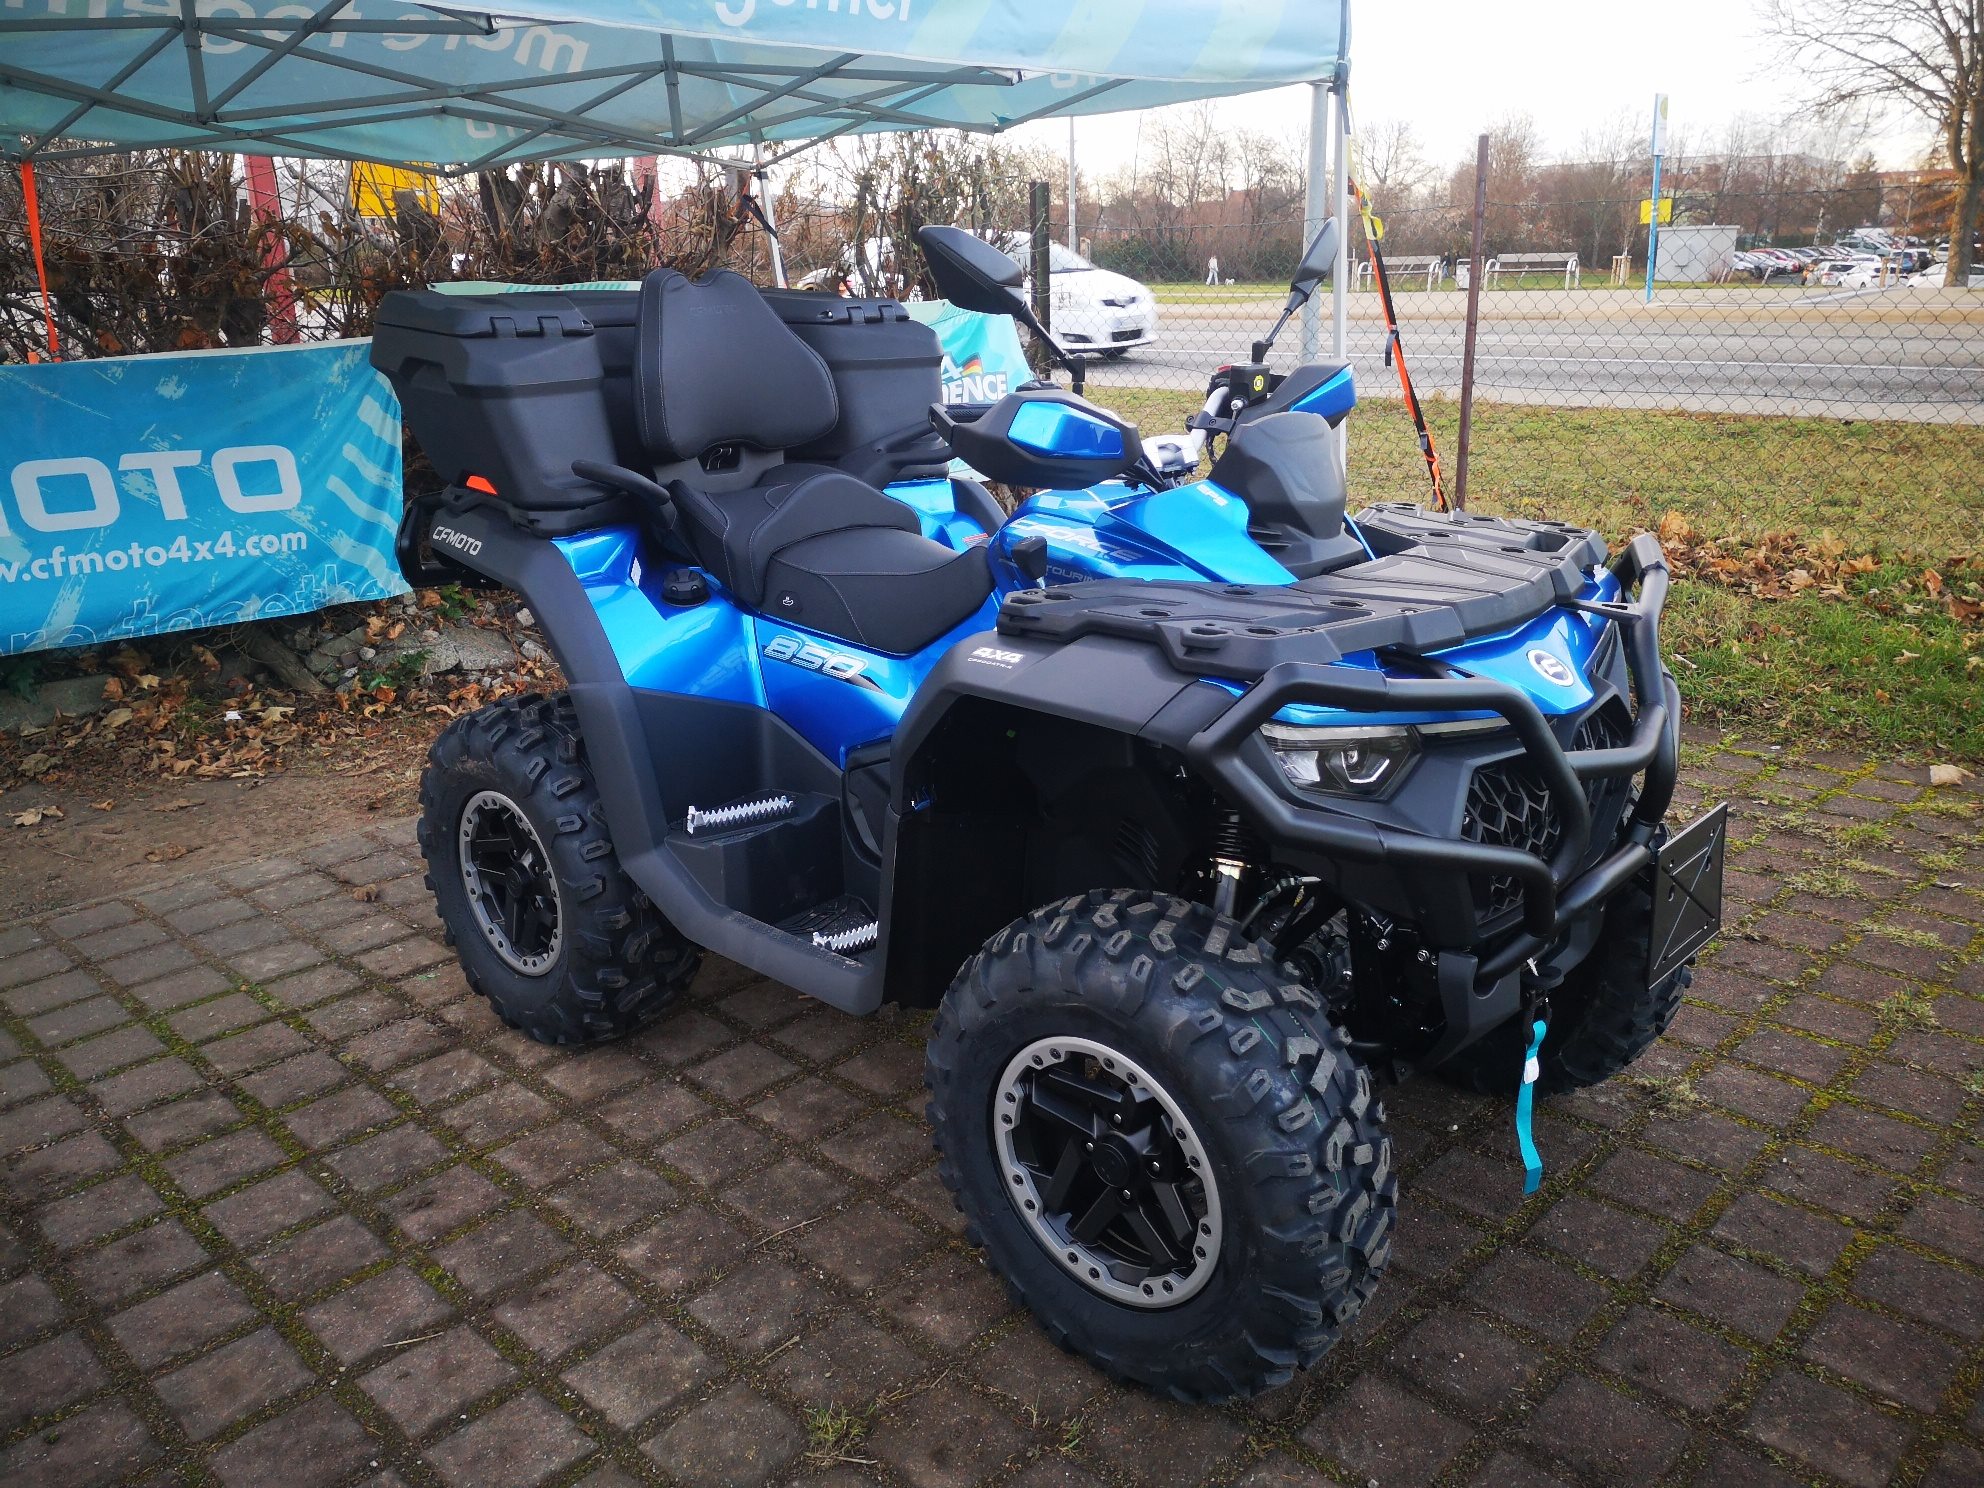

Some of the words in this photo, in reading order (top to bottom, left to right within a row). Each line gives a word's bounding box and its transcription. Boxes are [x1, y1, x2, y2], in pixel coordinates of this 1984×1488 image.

[0, 445, 301, 537] OTO
[432, 526, 482, 556] CFMOTO
[763, 634, 868, 680] 850
